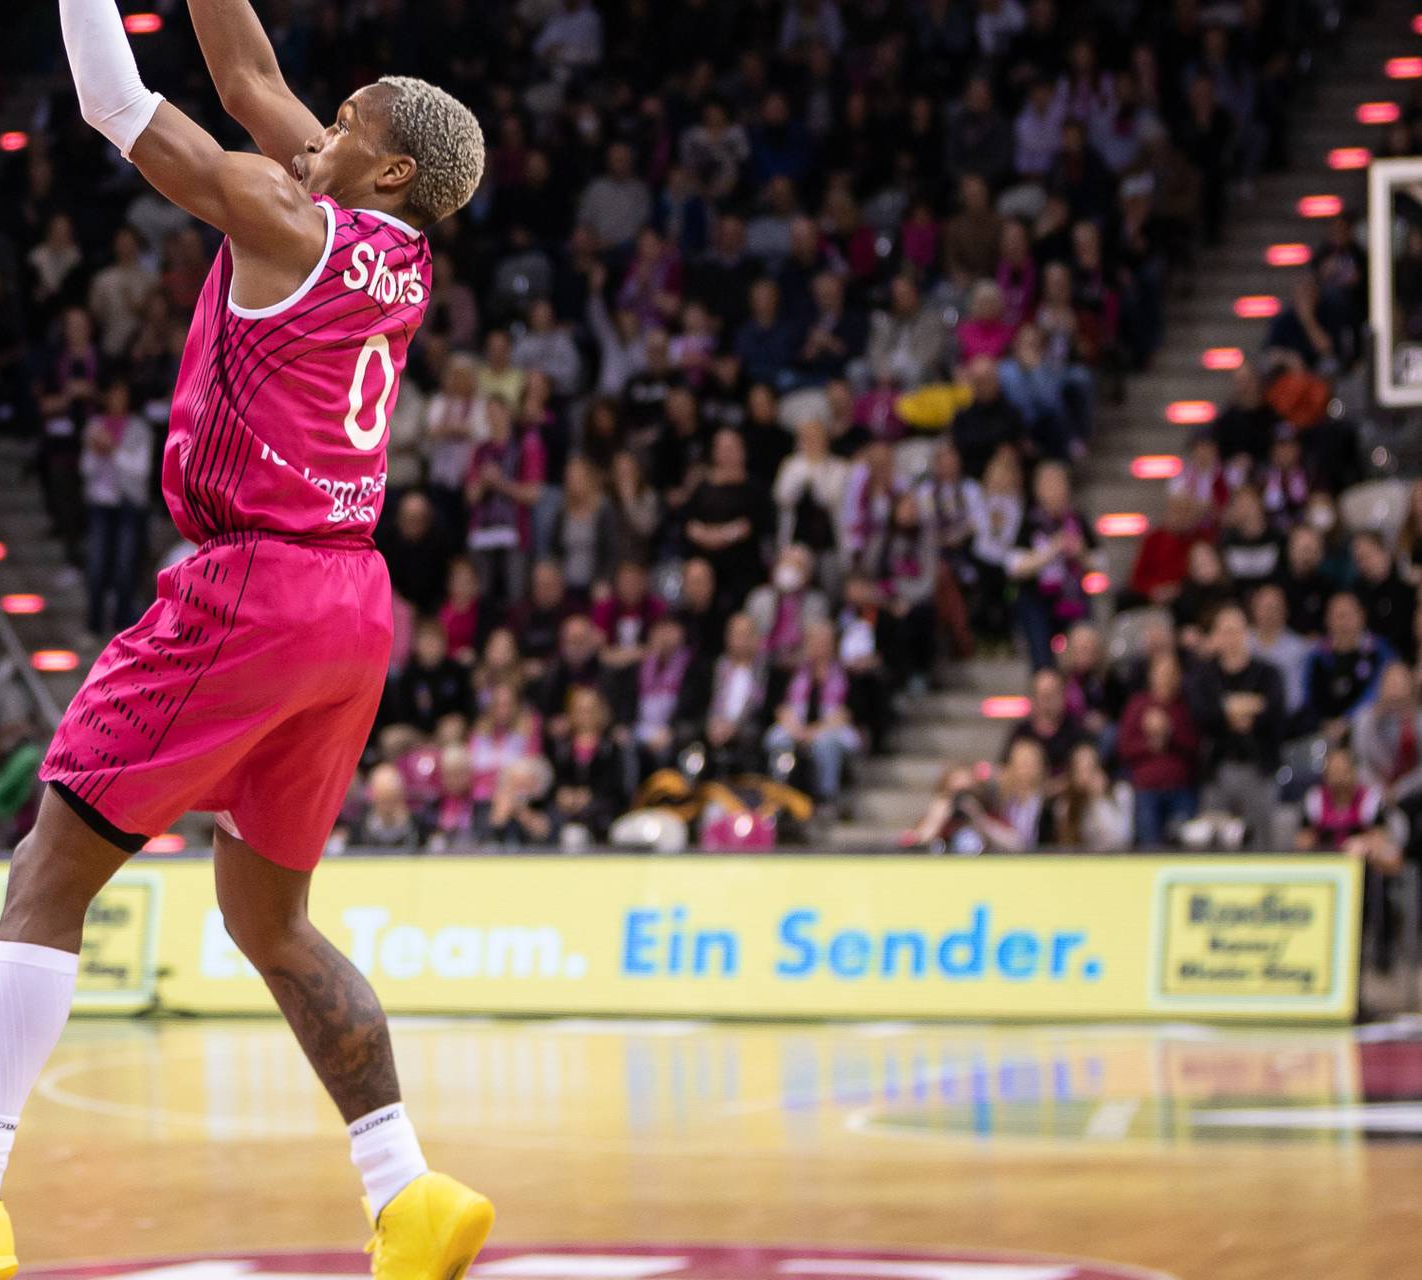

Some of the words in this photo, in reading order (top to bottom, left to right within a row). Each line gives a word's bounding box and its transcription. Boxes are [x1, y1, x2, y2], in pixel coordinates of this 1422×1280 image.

[344, 334, 395, 450] 0
[342, 905, 588, 980] Team.
[621, 905, 738, 978] Ein
[774, 902, 1102, 980] Sender.
